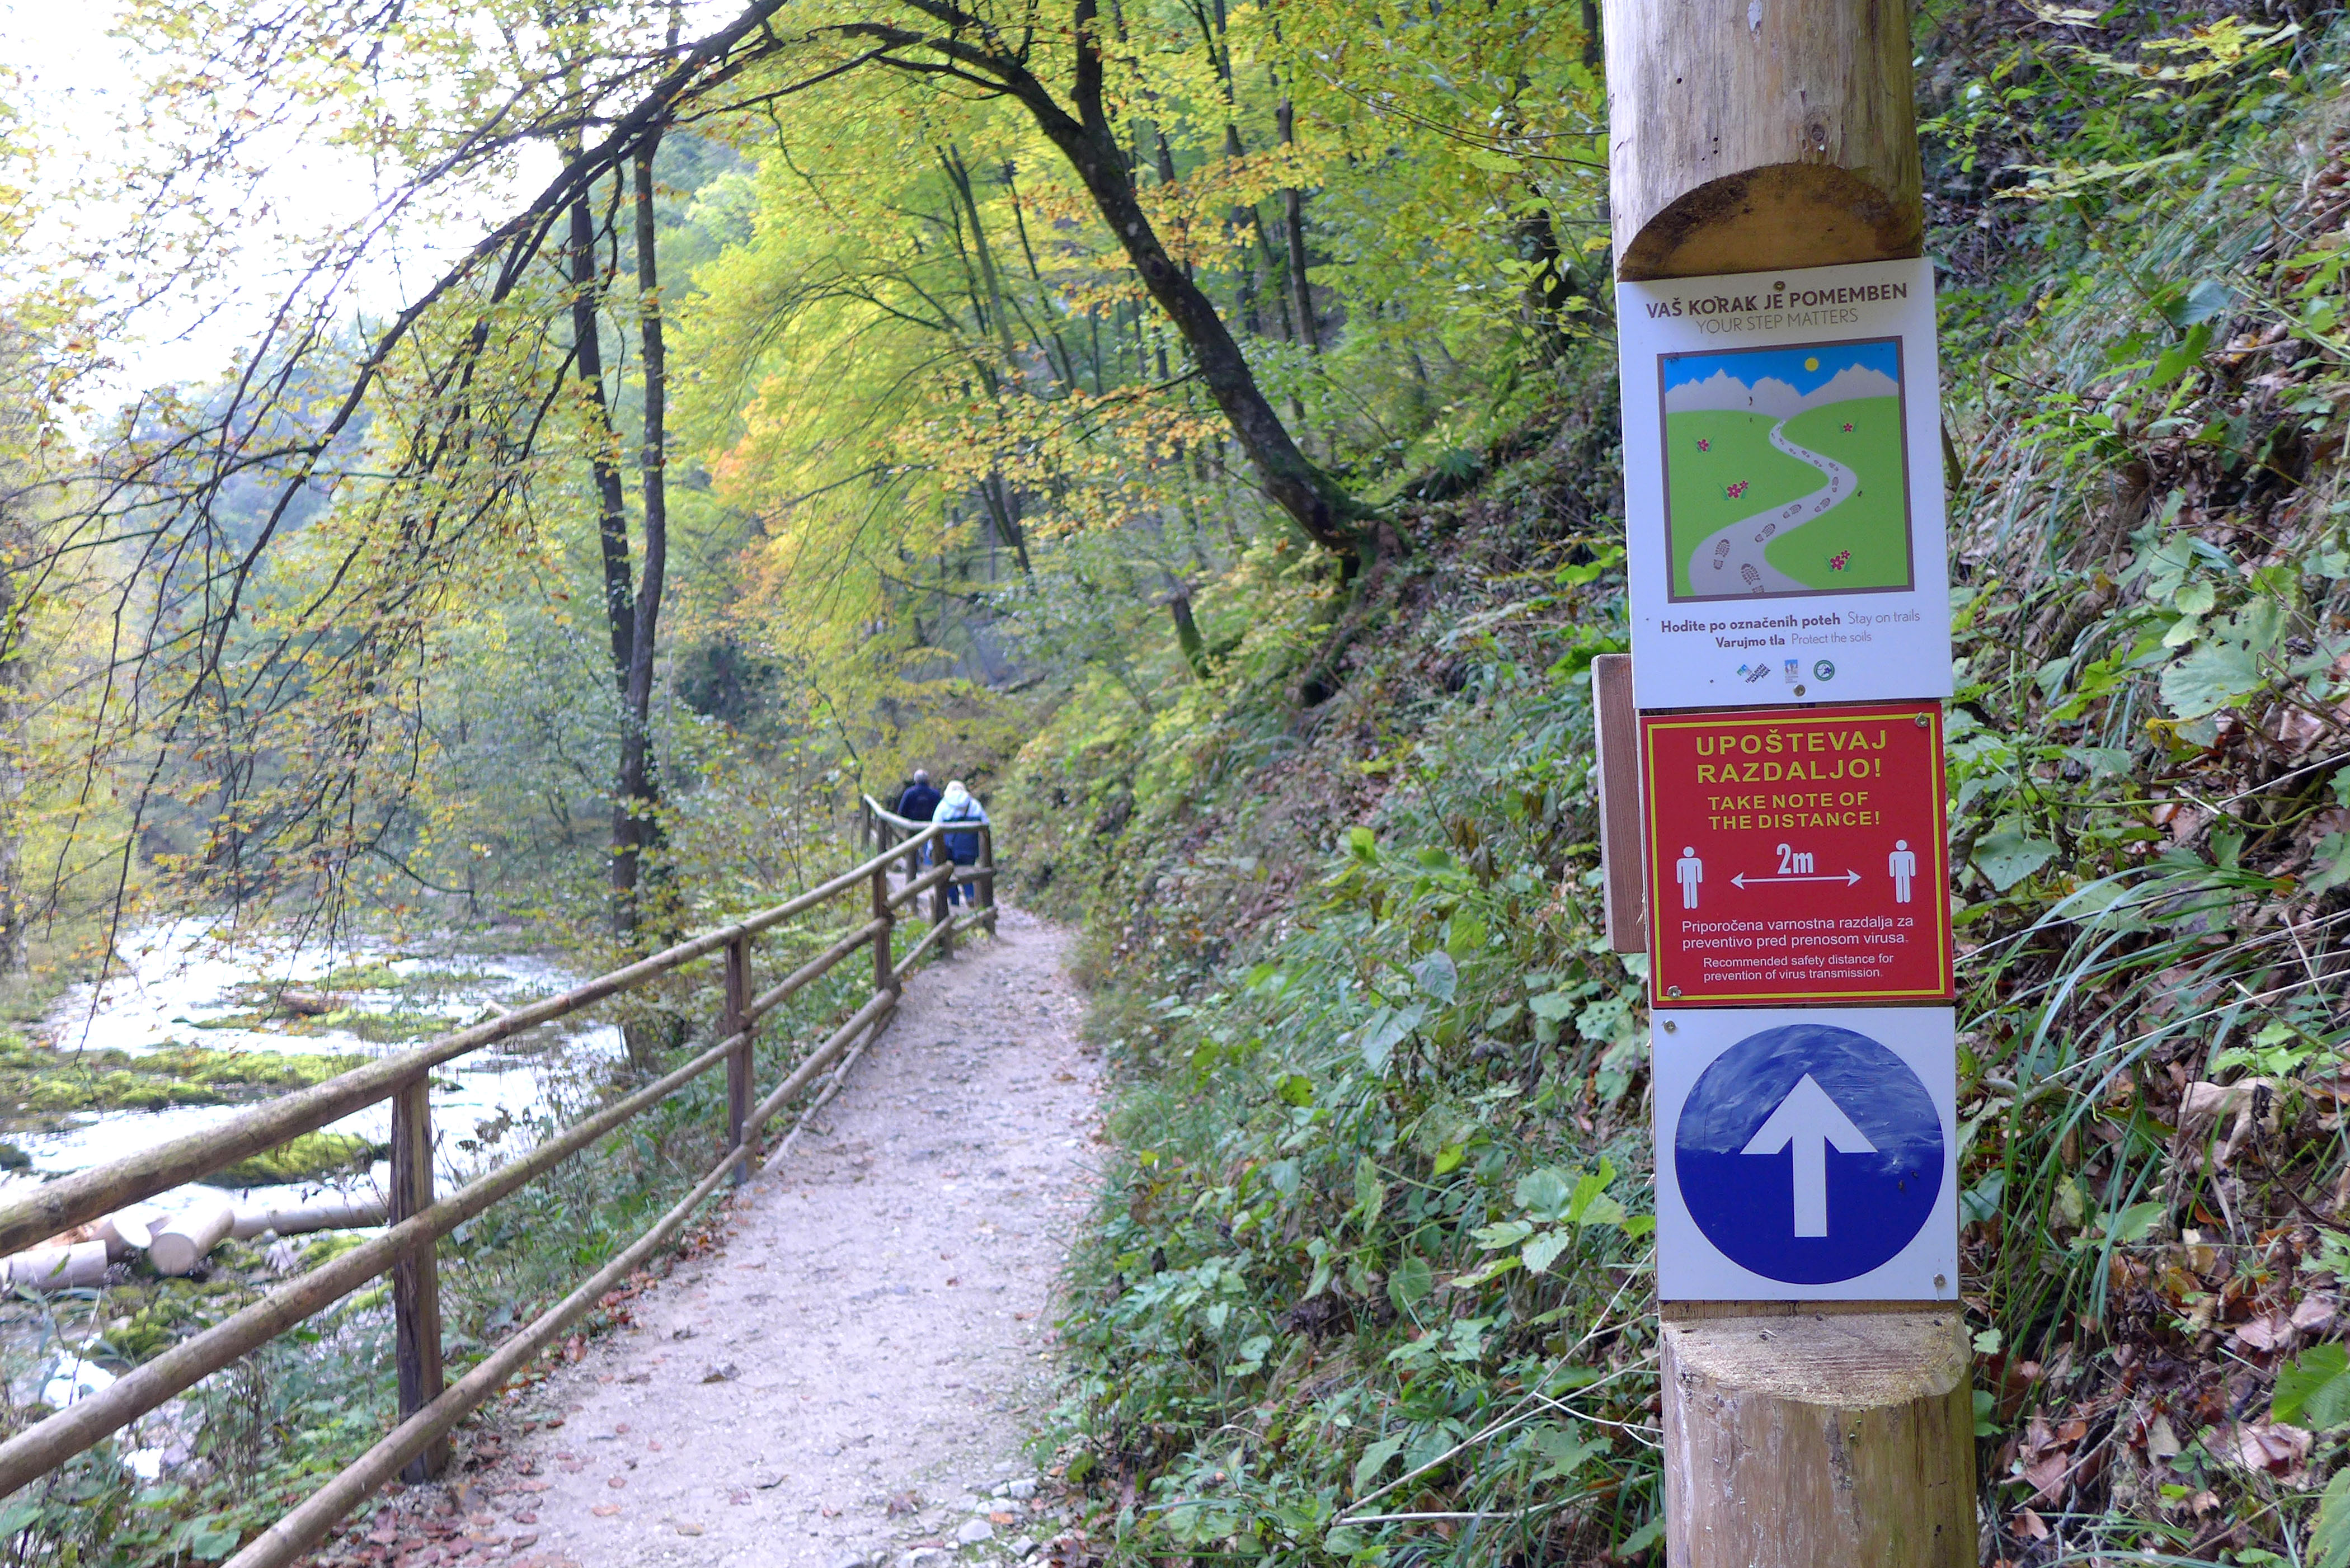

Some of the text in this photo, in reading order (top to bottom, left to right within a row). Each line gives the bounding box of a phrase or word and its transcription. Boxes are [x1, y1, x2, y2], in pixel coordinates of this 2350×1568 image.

[1646, 283, 1907, 318] VAŠ KORAK JE POMEMBEN
[1696, 308, 1858, 335] YOUR STEP MATTERS
[1661, 609, 1920, 634] Hodite po označenih poteh Stay on trails
[1716, 631, 1871, 651] Varujmo tla Protect the soils
[1696, 729, 1887, 756] UPOŠTEVAJ
[1697, 758, 1881, 784] RAZDALJO!
[1708, 791, 1869, 811] TAKE NOTE OF
[1709, 811, 1880, 830] THE DISTANCE!
[1776, 843, 1813, 874] 2m
[1682, 915, 1914, 935] Priporočena varnostna razdalja za
[1682, 935, 1752, 951] preventivo
[1756, 935, 1787, 949] pred
[1791, 935, 1859, 948] prenosom
[1703, 953, 1894, 968] Recommended safety distance for
[1703, 969, 1761, 983] prevention
[1765, 968, 1776, 980] of
[1779, 968, 1806, 979] virus
